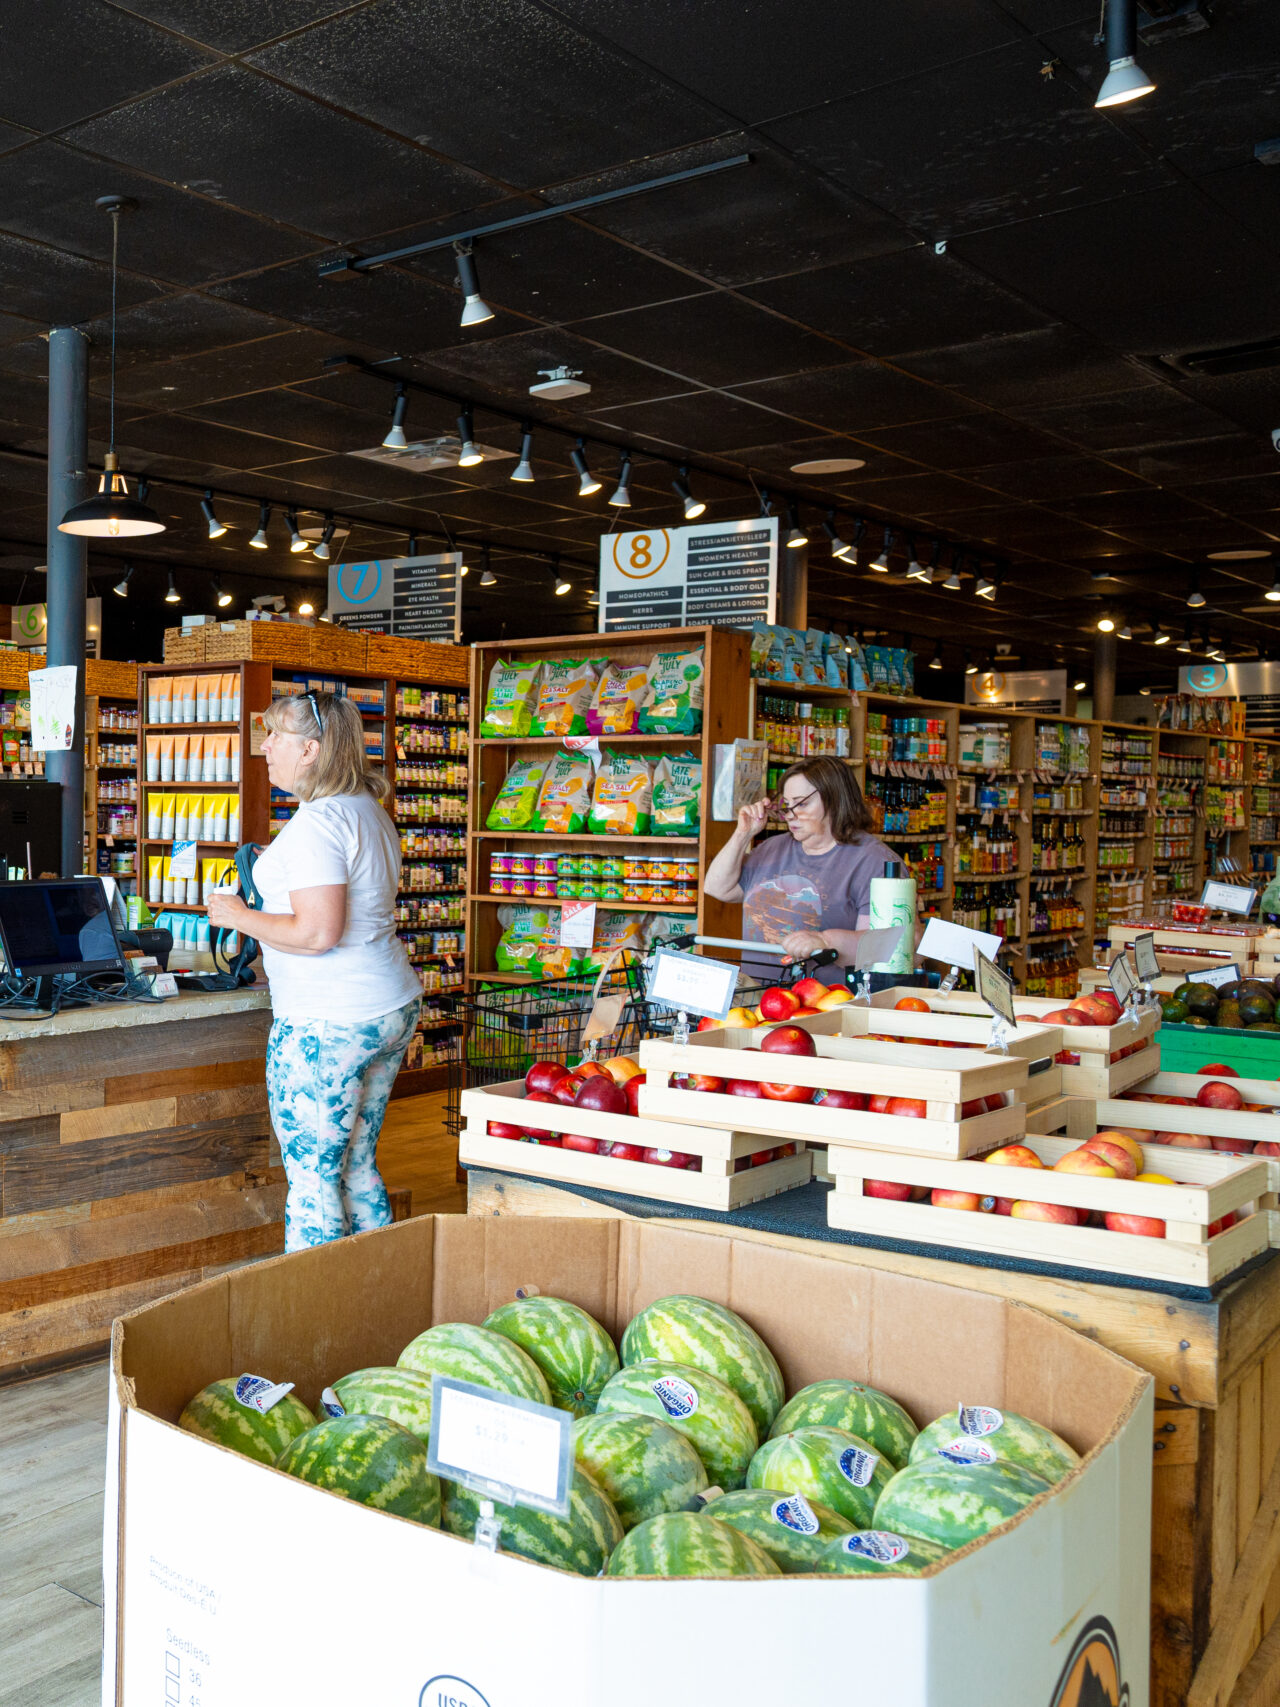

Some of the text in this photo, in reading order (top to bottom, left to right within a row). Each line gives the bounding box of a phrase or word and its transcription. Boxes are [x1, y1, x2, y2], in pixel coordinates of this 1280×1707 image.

[629, 534, 652, 569] 8
[698, 551, 759, 563] WOMEN'S HEALTH
[688, 566, 767, 579] SUN CARE & BUG SPRAYS
[352, 564, 370, 595] 7
[410, 581, 437, 589] MINERALS
[618, 590, 669, 600] HOMEOPATHICS
[689, 586, 723, 595] ESSENTIAL
[730, 584, 748, 592] BODY
[632, 606, 654, 615] HERBS
[687, 602, 705, 611] BODY
[705, 600, 732, 610] CREAMS
[738, 598, 766, 607] LOTIONS
[26, 606, 38, 631] 6
[404, 608, 443, 617] HEART HEALTH
[613, 621, 671, 631] IMMUNE SUPPORT
[687, 618, 710, 627] SOAPS
[716, 615, 765, 625] DEODORANTS
[661, 660, 681, 674] JULY
[498, 671, 519, 682] JULY
[1200, 666, 1216, 686] 3
[981, 675, 995, 691] 4
[609, 764, 631, 776] JULY
[671, 764, 691, 777] LATE
[671, 776, 692, 786] JULY
[513, 903, 531, 918] JULY
[563, 902, 583, 918] SALE
[605, 914, 626, 926] JULY
[241, 1380, 271, 1405] ORGANIC
[654, 1382, 691, 1414] ORGANIC
[853, 1451, 868, 1485] ORGANIC
[787, 1498, 816, 1532] ORGANIC
[861, 1532, 891, 1561] ORGANIC
[166, 1627, 210, 1666] Seedless
[189, 1668, 201, 1687] 36
